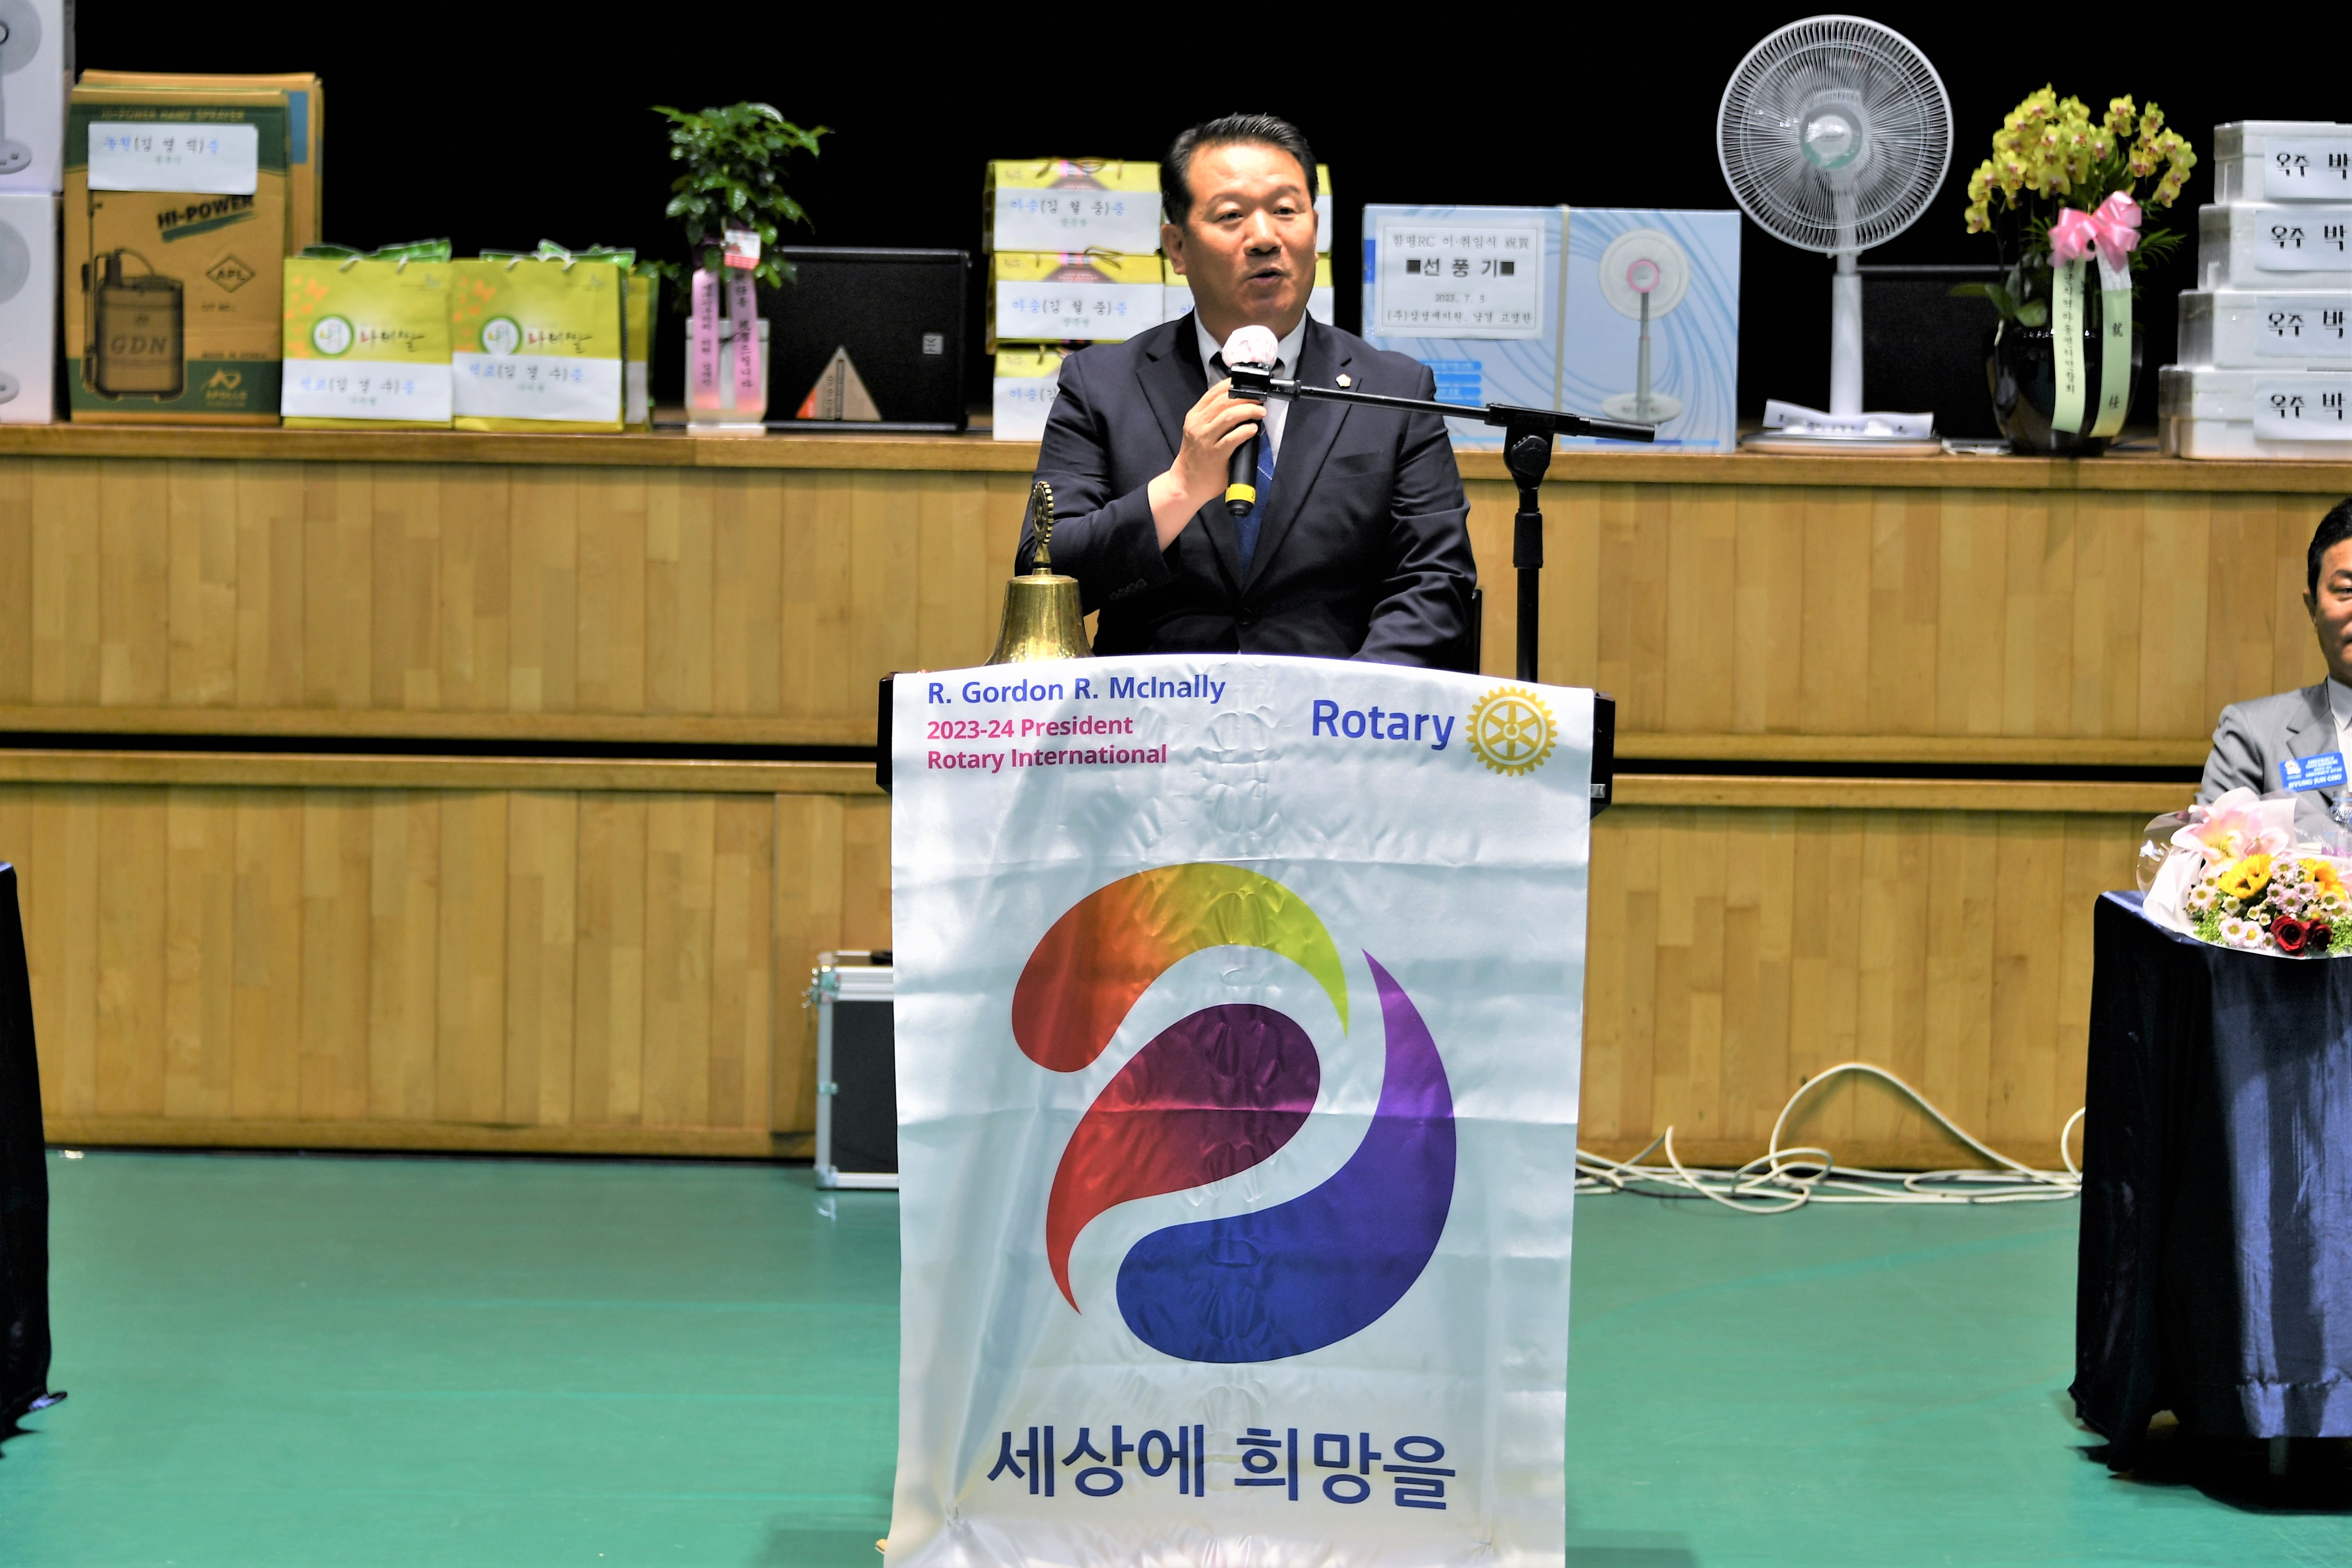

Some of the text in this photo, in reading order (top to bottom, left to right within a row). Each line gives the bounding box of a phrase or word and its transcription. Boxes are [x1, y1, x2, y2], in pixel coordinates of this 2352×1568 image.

[2329, 151, 2351, 179] 박
[1393, 234, 1435, 248] 함평RC
[2324, 224, 2347, 252] 박
[1424, 258, 1497, 278] 선 풍 기
[2323, 309, 2347, 339] 박
[2323, 392, 2347, 421] 박
[928, 675, 1226, 704] R. Gordon R. McInally
[927, 716, 1133, 740] 2023-24 President
[1312, 699, 1455, 751] Rotary
[927, 744, 1167, 773] Rotary International
[987, 1423, 1456, 1510] 세상에 희망을
